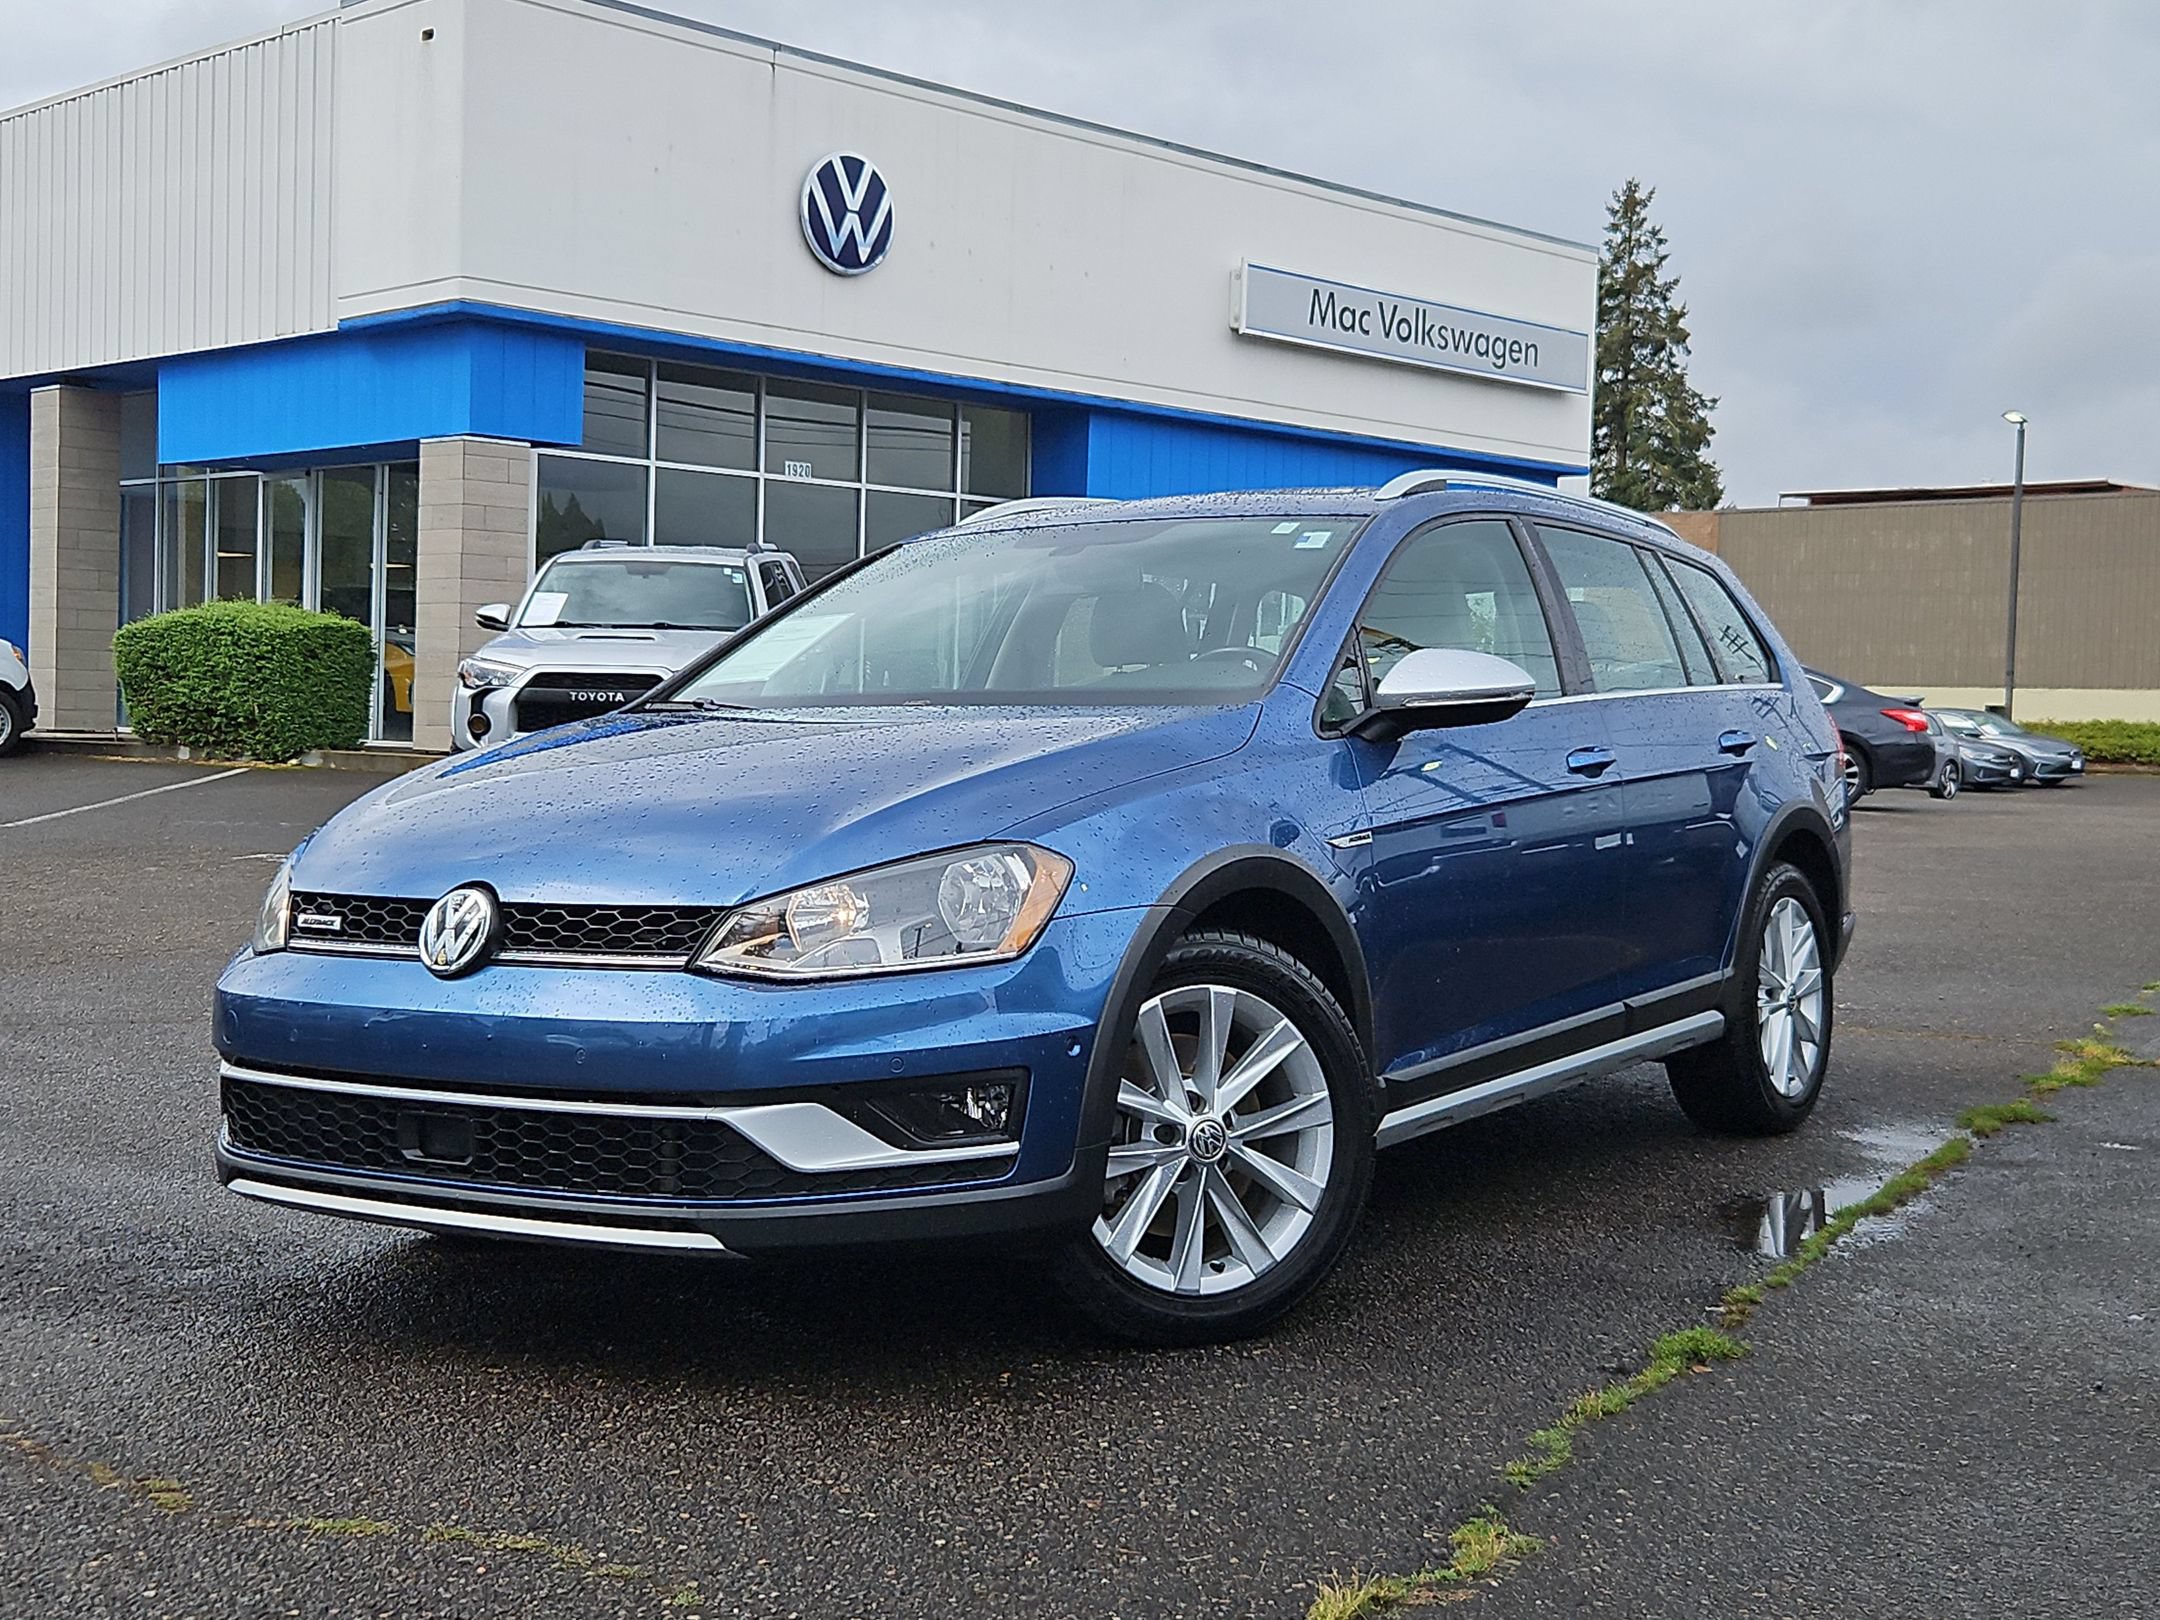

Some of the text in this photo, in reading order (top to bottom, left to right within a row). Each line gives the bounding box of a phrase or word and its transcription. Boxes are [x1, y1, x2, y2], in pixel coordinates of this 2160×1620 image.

[1308, 288, 1539, 370] Mac Volkswagen
[786, 463, 811, 478] 1920
[569, 691, 625, 702] TOYOTA
